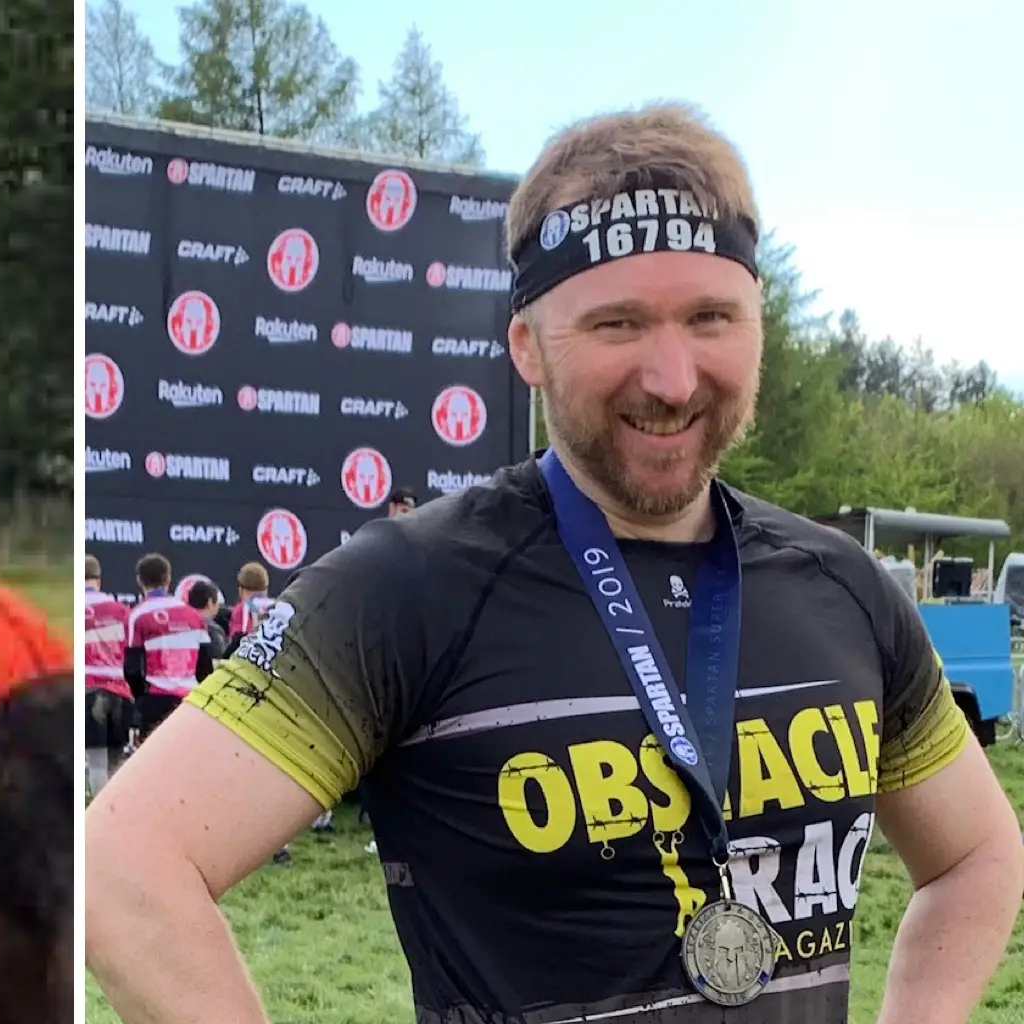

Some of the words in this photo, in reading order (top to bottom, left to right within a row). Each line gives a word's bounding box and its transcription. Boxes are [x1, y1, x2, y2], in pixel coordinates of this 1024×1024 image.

[85, 146, 153, 174] Rakuten
[188, 162, 256, 192] SPARTAN
[278, 176, 333, 197] CRAFT
[177, 240, 235, 262] CRAFT
[582, 218, 716, 262] 16794
[352, 255, 414, 281] Rakuten
[446, 265, 512, 291] SPARTAN
[255, 316, 318, 342] Rakuten
[350, 326, 413, 353] SPARTAN
[432, 337, 489, 356] CRAFT
[158, 378, 223, 405] Rakuten
[257, 389, 320, 415] SPARTAN
[341, 397, 395, 417] CRAFT
[166, 453, 230, 480] SPARTAN
[253, 466, 307, 484] CRAFT
[169, 524, 225, 542] CRAFT
[583, 547, 633, 616] 2019
[627, 644, 686, 737] SPARTAN
